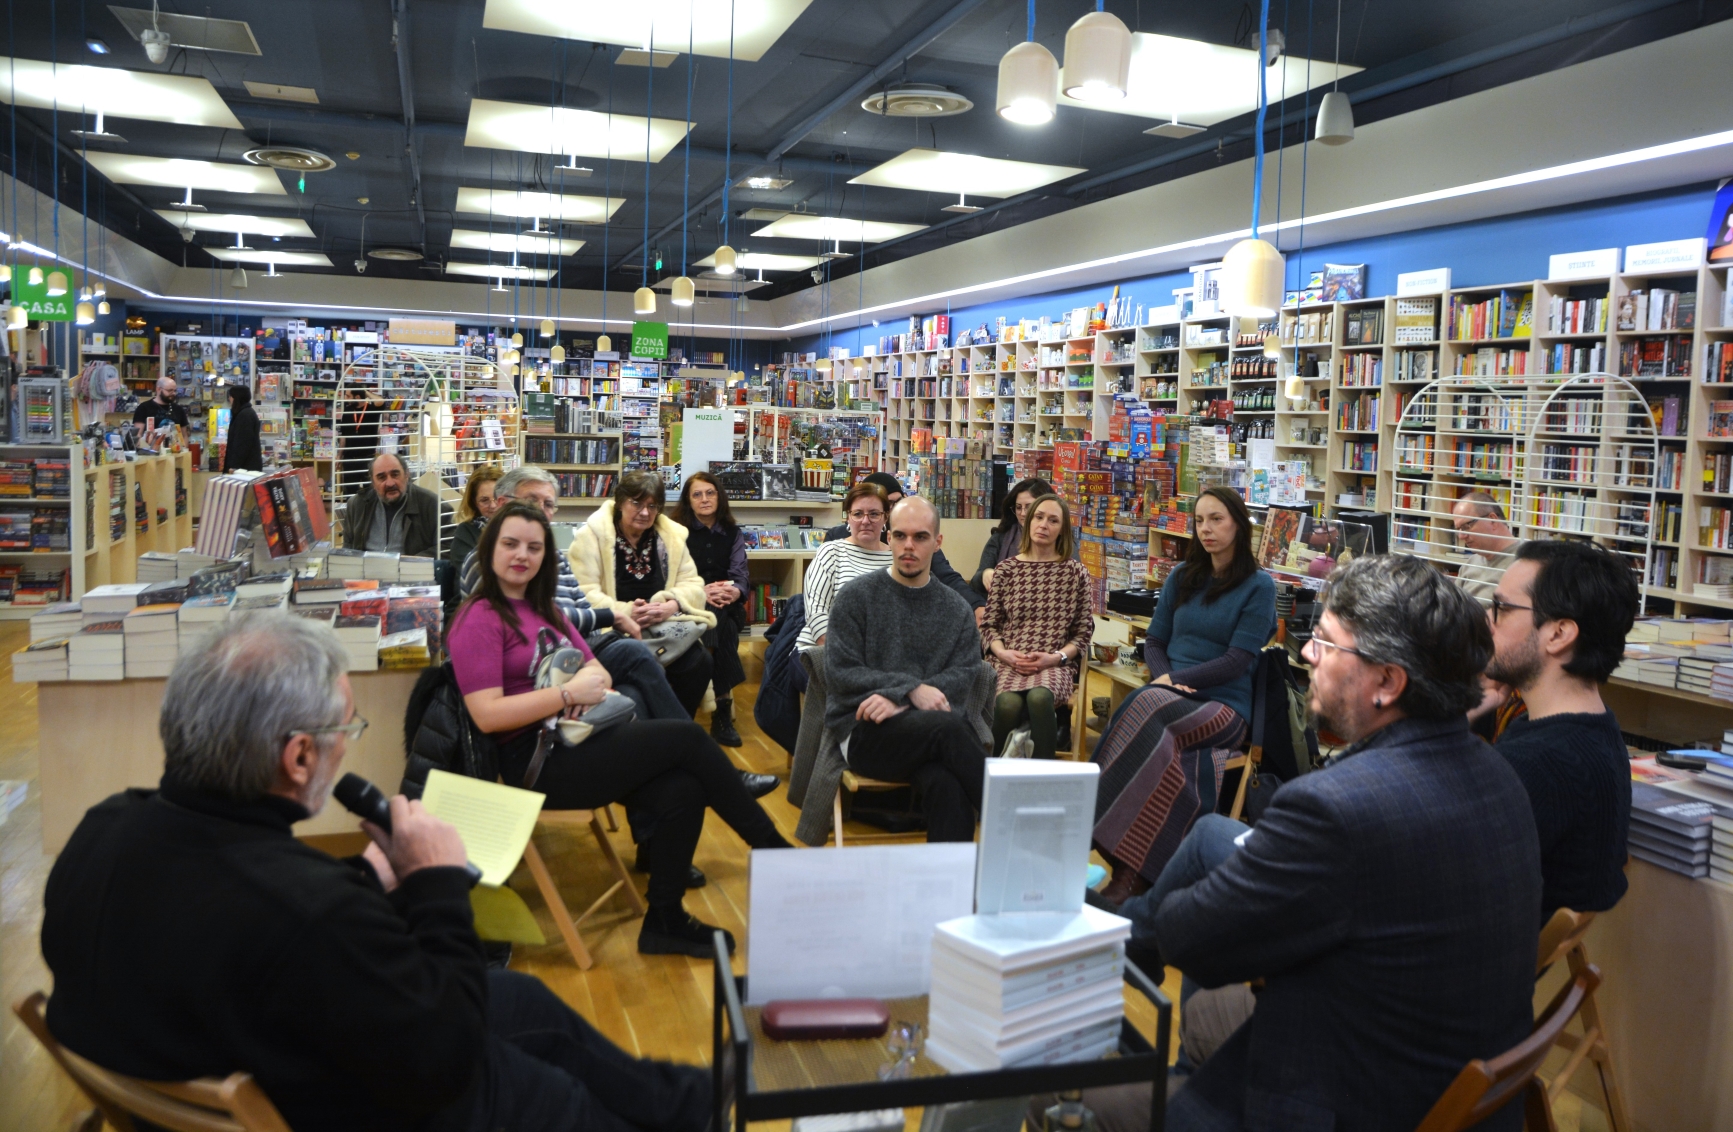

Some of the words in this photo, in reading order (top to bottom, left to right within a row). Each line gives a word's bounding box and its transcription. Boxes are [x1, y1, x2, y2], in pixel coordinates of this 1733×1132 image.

[1662, 254, 1694, 265] JURNALE
[20, 301, 67, 315] CASA
[635, 337, 663, 347] ZONA
[634, 346, 665, 356] COPII
[695, 413, 723, 421] MUZICĂ
[1088, 473, 1103, 481] CATAN
[1089, 484, 1104, 492] CATAN
